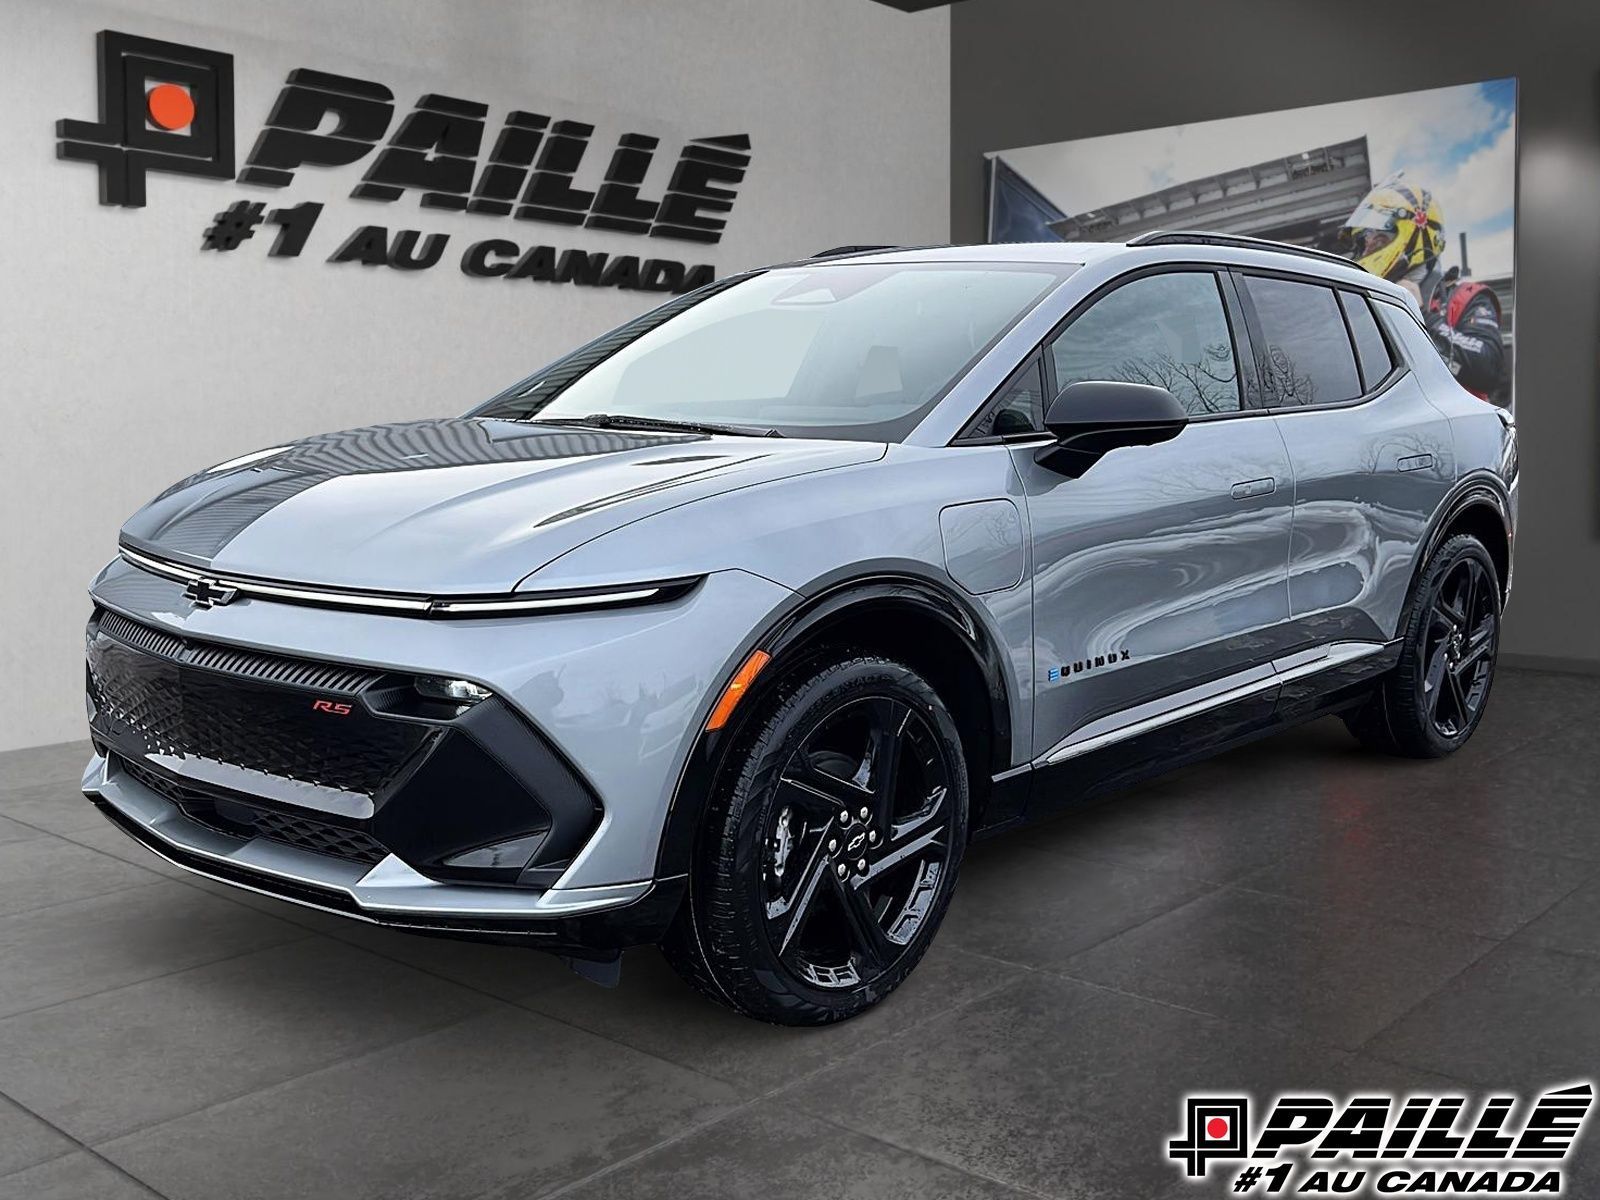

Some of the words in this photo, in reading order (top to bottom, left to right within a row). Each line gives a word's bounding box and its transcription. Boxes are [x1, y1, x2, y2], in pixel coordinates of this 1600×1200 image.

[236, 67, 752, 244] PAILLÉ
[200, 200, 325, 258] #1
[326, 225, 451, 271] AU
[459, 238, 716, 295] CANADA
[1048, 649, 1131, 682] EQUINOX
[312, 700, 353, 715] RS
